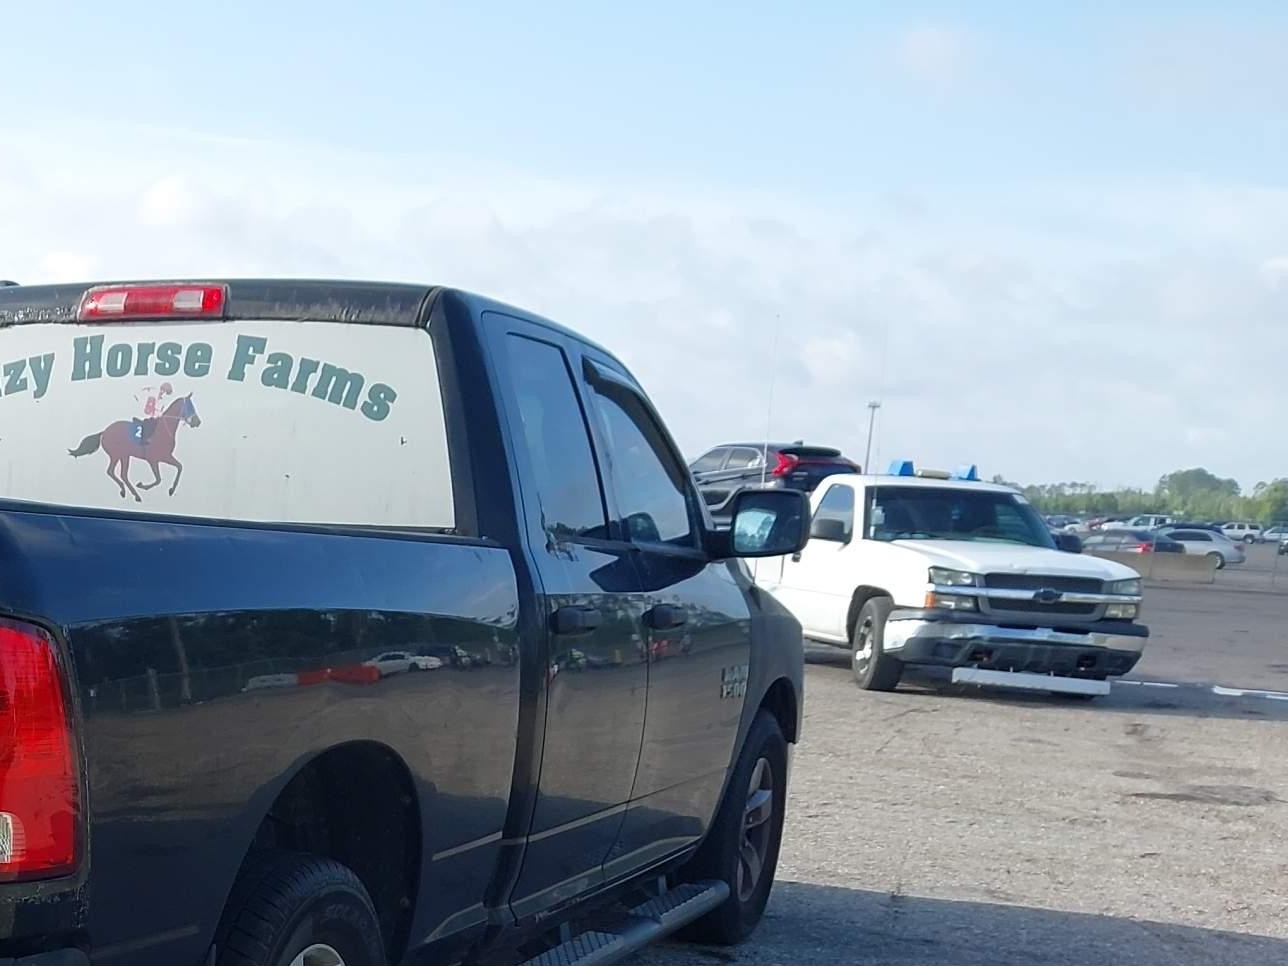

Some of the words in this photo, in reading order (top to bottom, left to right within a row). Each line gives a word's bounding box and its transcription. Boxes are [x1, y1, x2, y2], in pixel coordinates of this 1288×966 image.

[71, 334, 213, 381] Horse
[227, 334, 397, 422] Farms
[135, 425, 143, 439] 2
